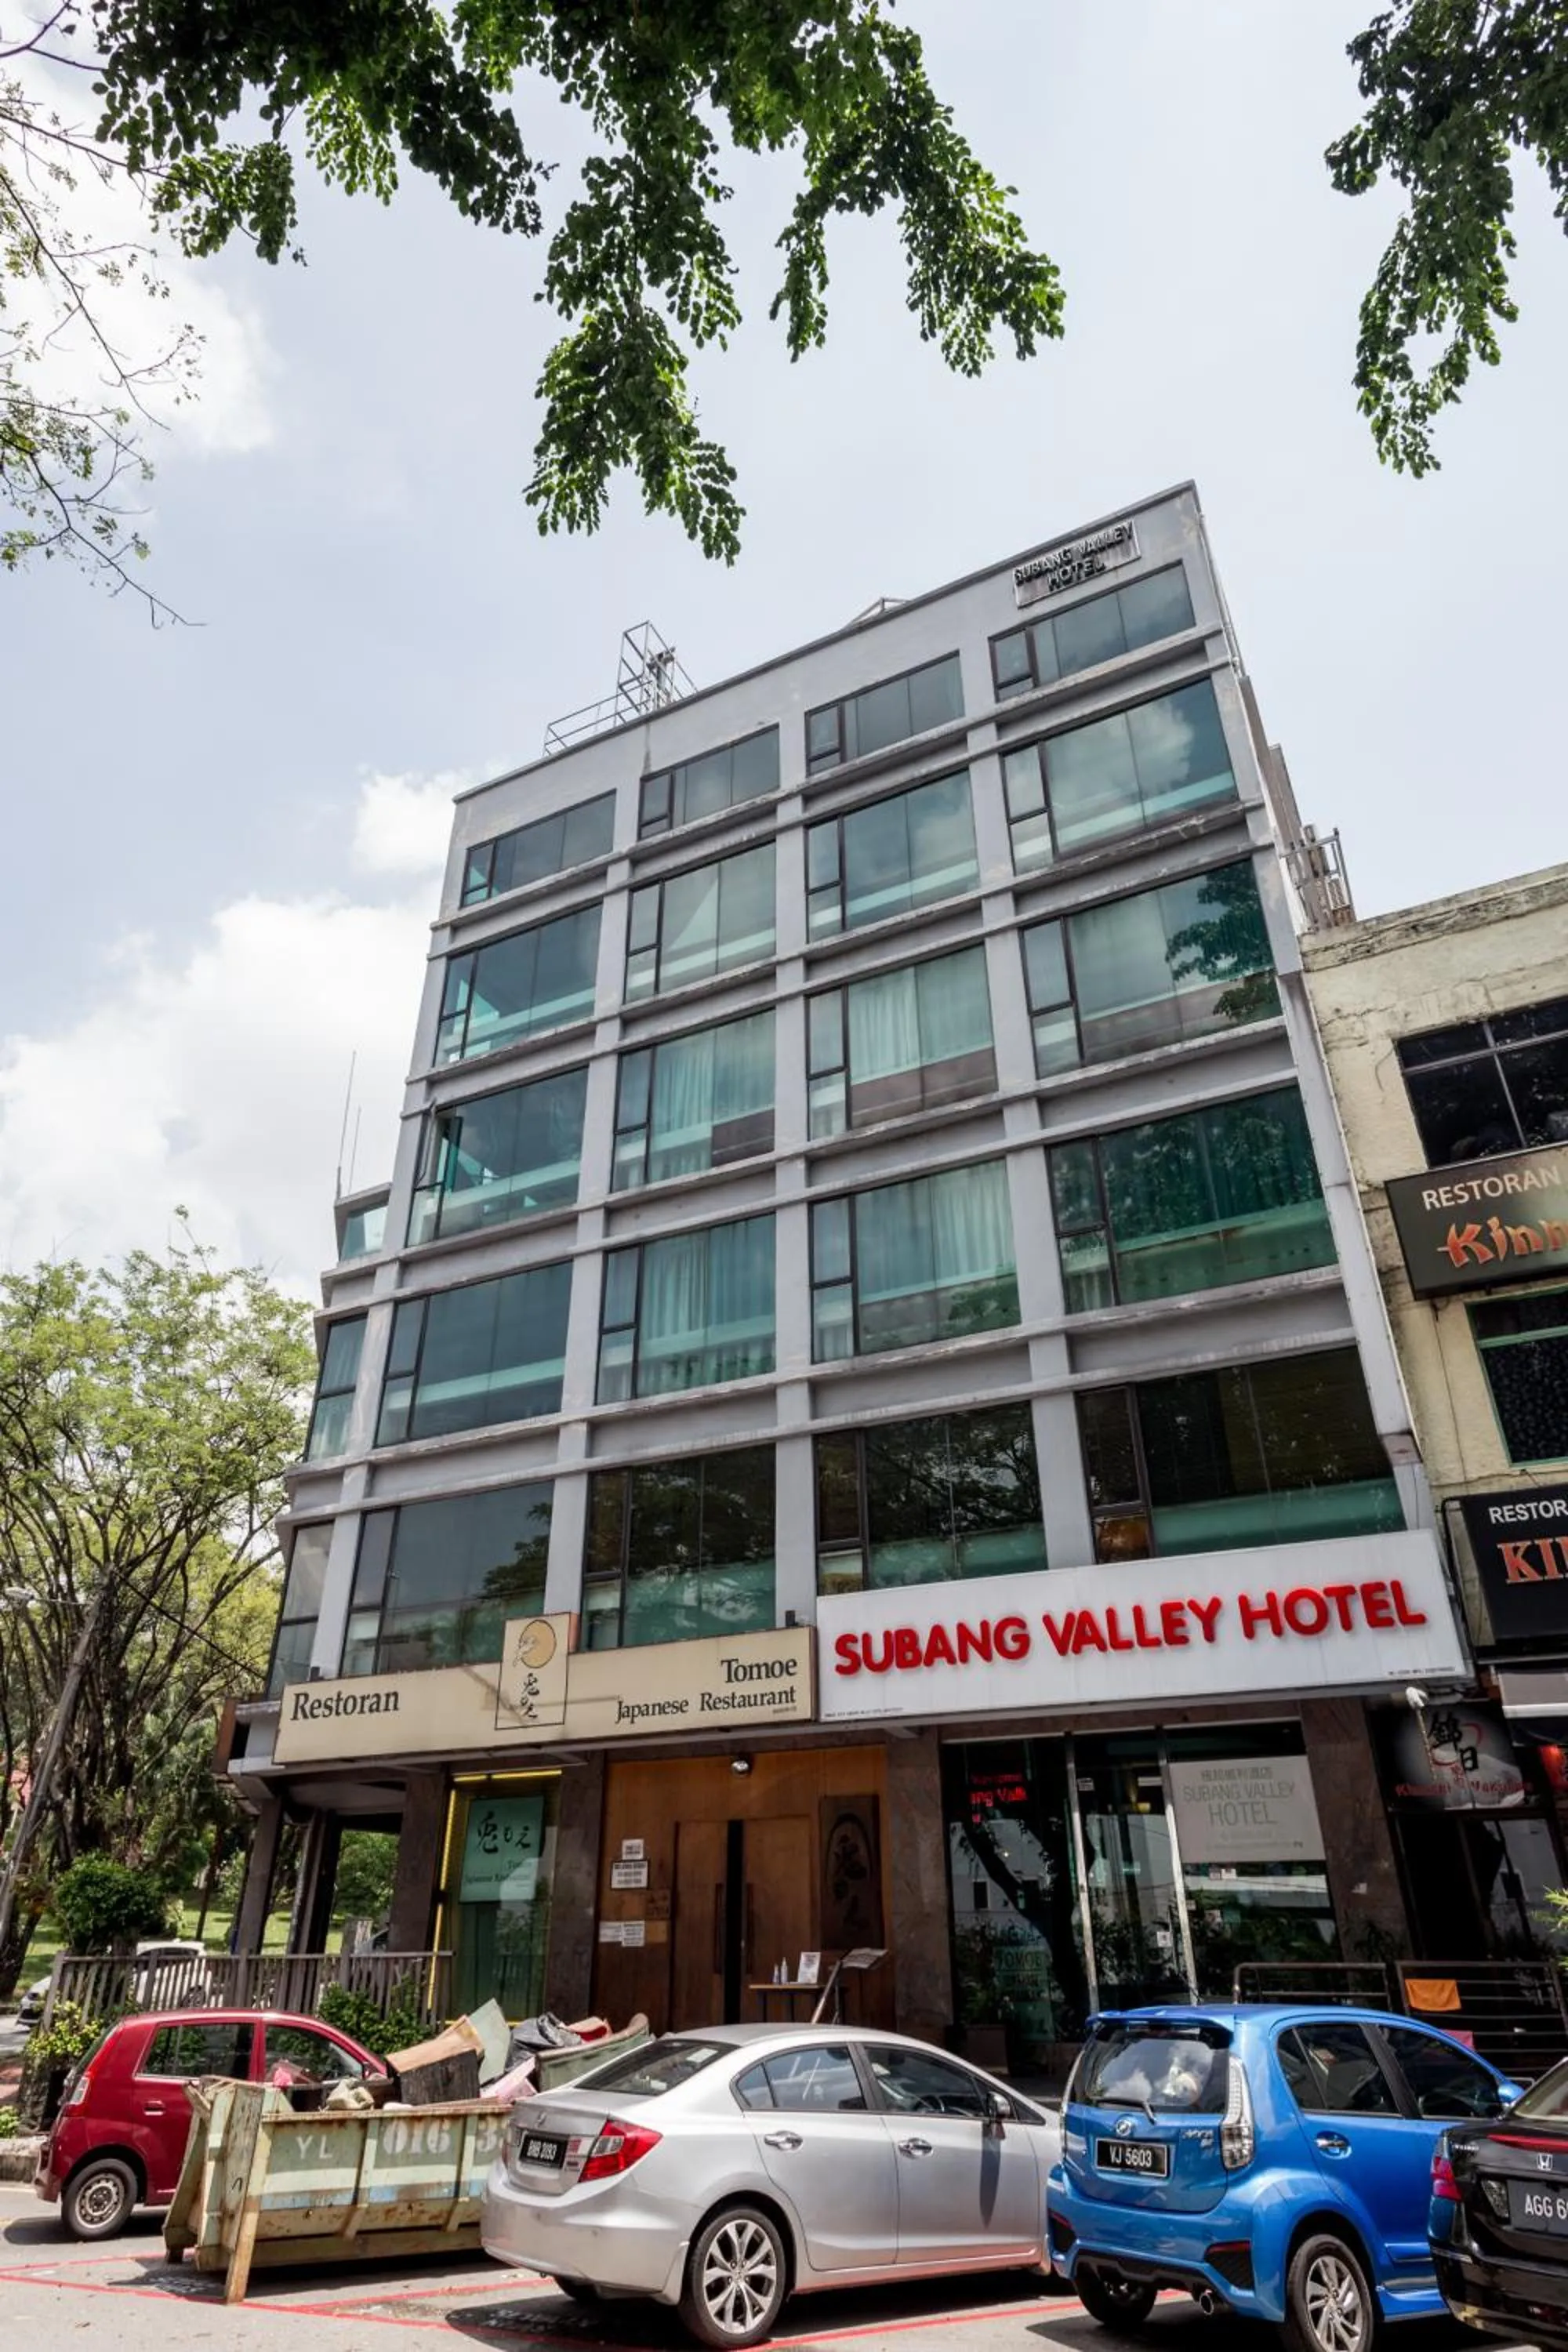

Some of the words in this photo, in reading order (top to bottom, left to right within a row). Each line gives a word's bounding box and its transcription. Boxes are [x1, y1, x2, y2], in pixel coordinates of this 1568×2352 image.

[1014, 548, 1072, 586] SUBANG
[1077, 520, 1134, 559] VALLEY
[1047, 554, 1106, 592] HOTEL
[1421, 1165, 1562, 1211] RESTORAN
[835, 1616, 1031, 1675] SUBANG
[1042, 1596, 1222, 1657] VALLEY
[1238, 1580, 1427, 1640] HOTEL
[720, 1658, 797, 1683] Tomoe
[290, 1690, 400, 1721] Restoran
[615, 1699, 689, 1725] Japanese
[699, 1686, 797, 1712] Restaurant
[1182, 1782, 1240, 1802] SUBANG
[1244, 1780, 1295, 1800] VALLEY
[1207, 1802, 1278, 1827] HOTEL
[382, 2118, 451, 2154] 016
[1109, 2144, 1122, 2164] VJ
[1125, 2147, 1152, 2168] 5603
[1525, 2193, 1552, 2218] AGG
[1556, 2198, 1568, 2220] 6
